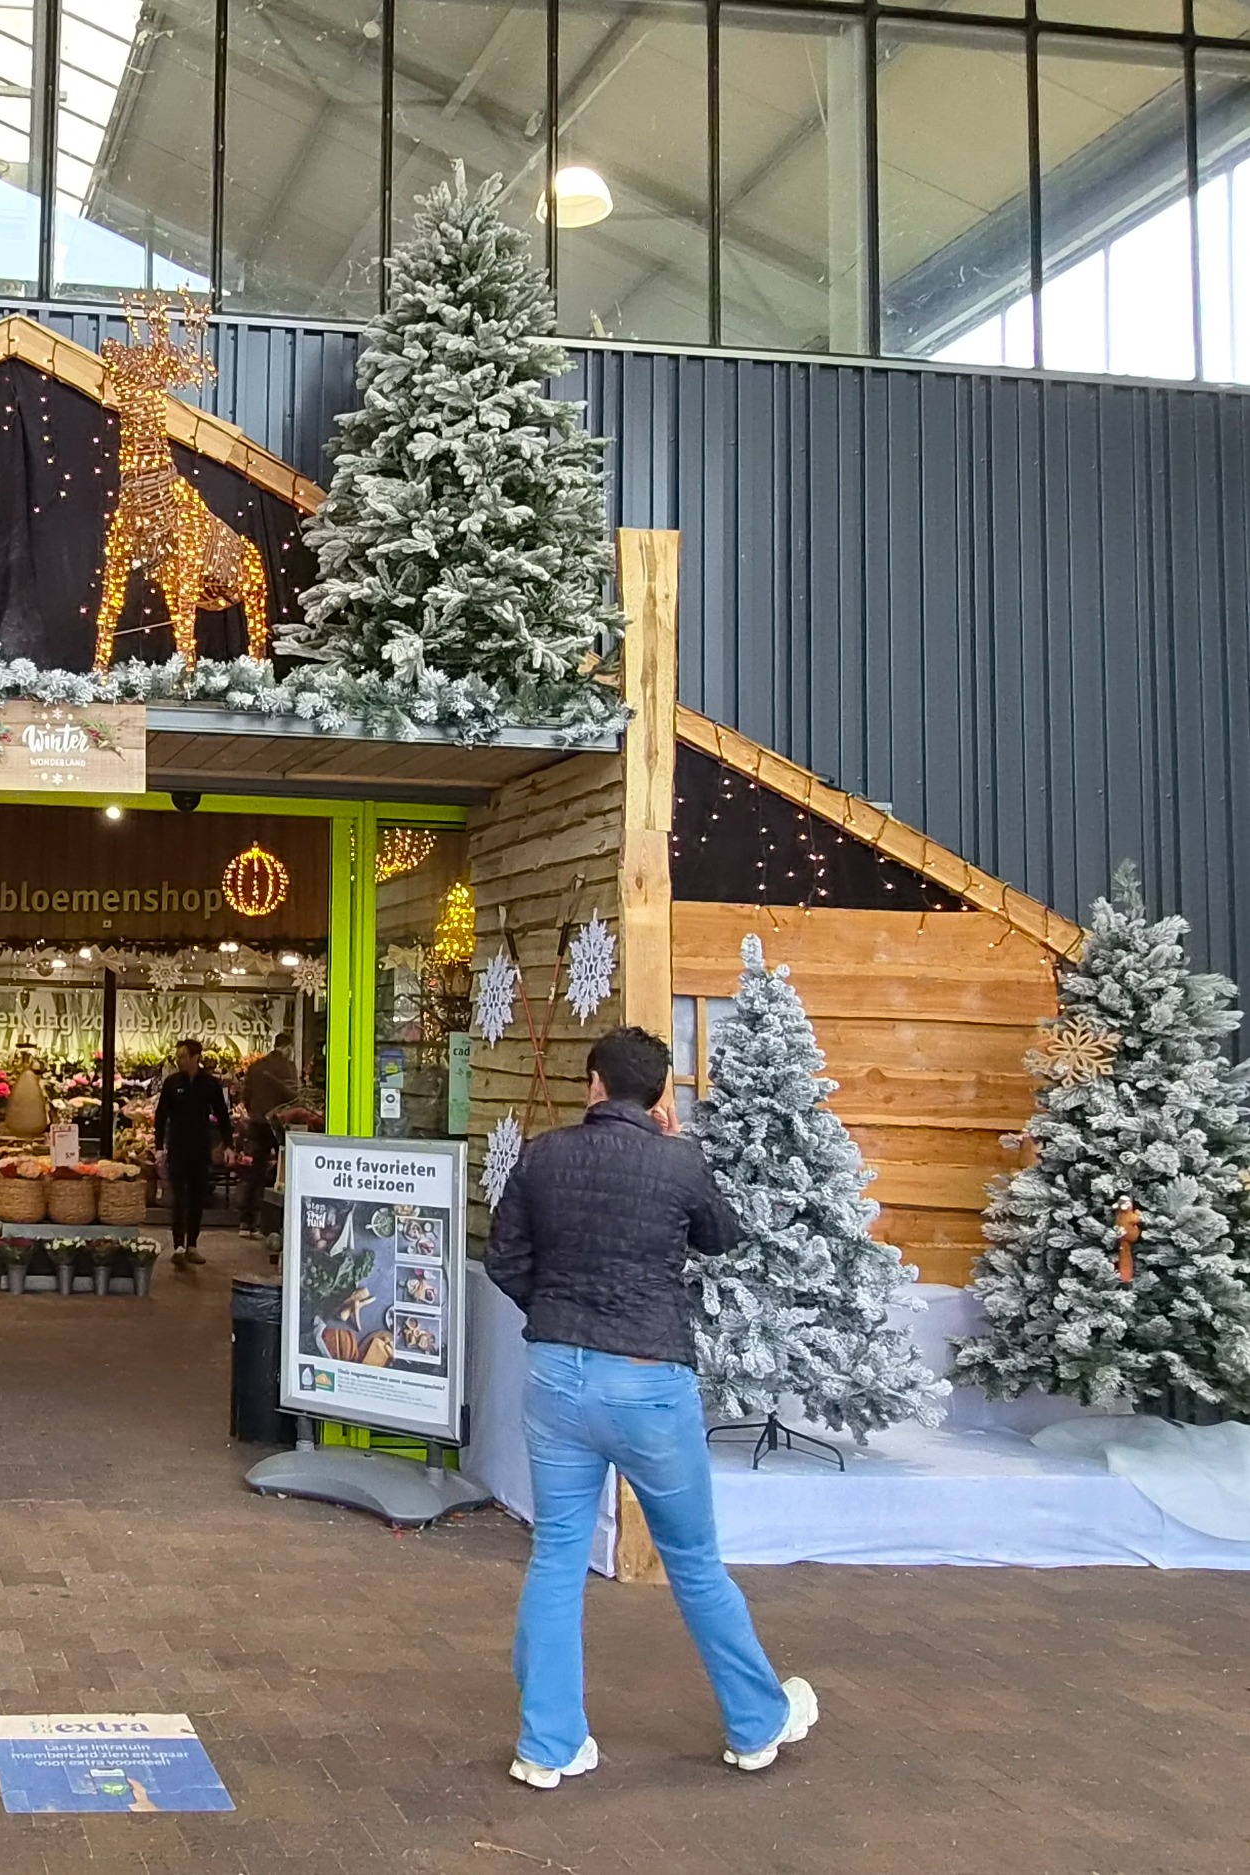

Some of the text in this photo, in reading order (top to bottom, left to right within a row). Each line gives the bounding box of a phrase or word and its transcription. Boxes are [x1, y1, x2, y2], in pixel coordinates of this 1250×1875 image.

[22, 723, 90, 753] Winter
[30, 757, 86, 767] WONDERLAND
[0, 881, 222, 919] bloemenshop
[34, 1009, 73, 1036] dag
[81, 1013, 161, 1034] zoder
[167, 1011, 267, 1036] bloemen
[314, 1155, 436, 1178] Onze favorieten
[333, 1172, 415, 1193] dit seizoen
[55, 1721, 150, 1733] extra
